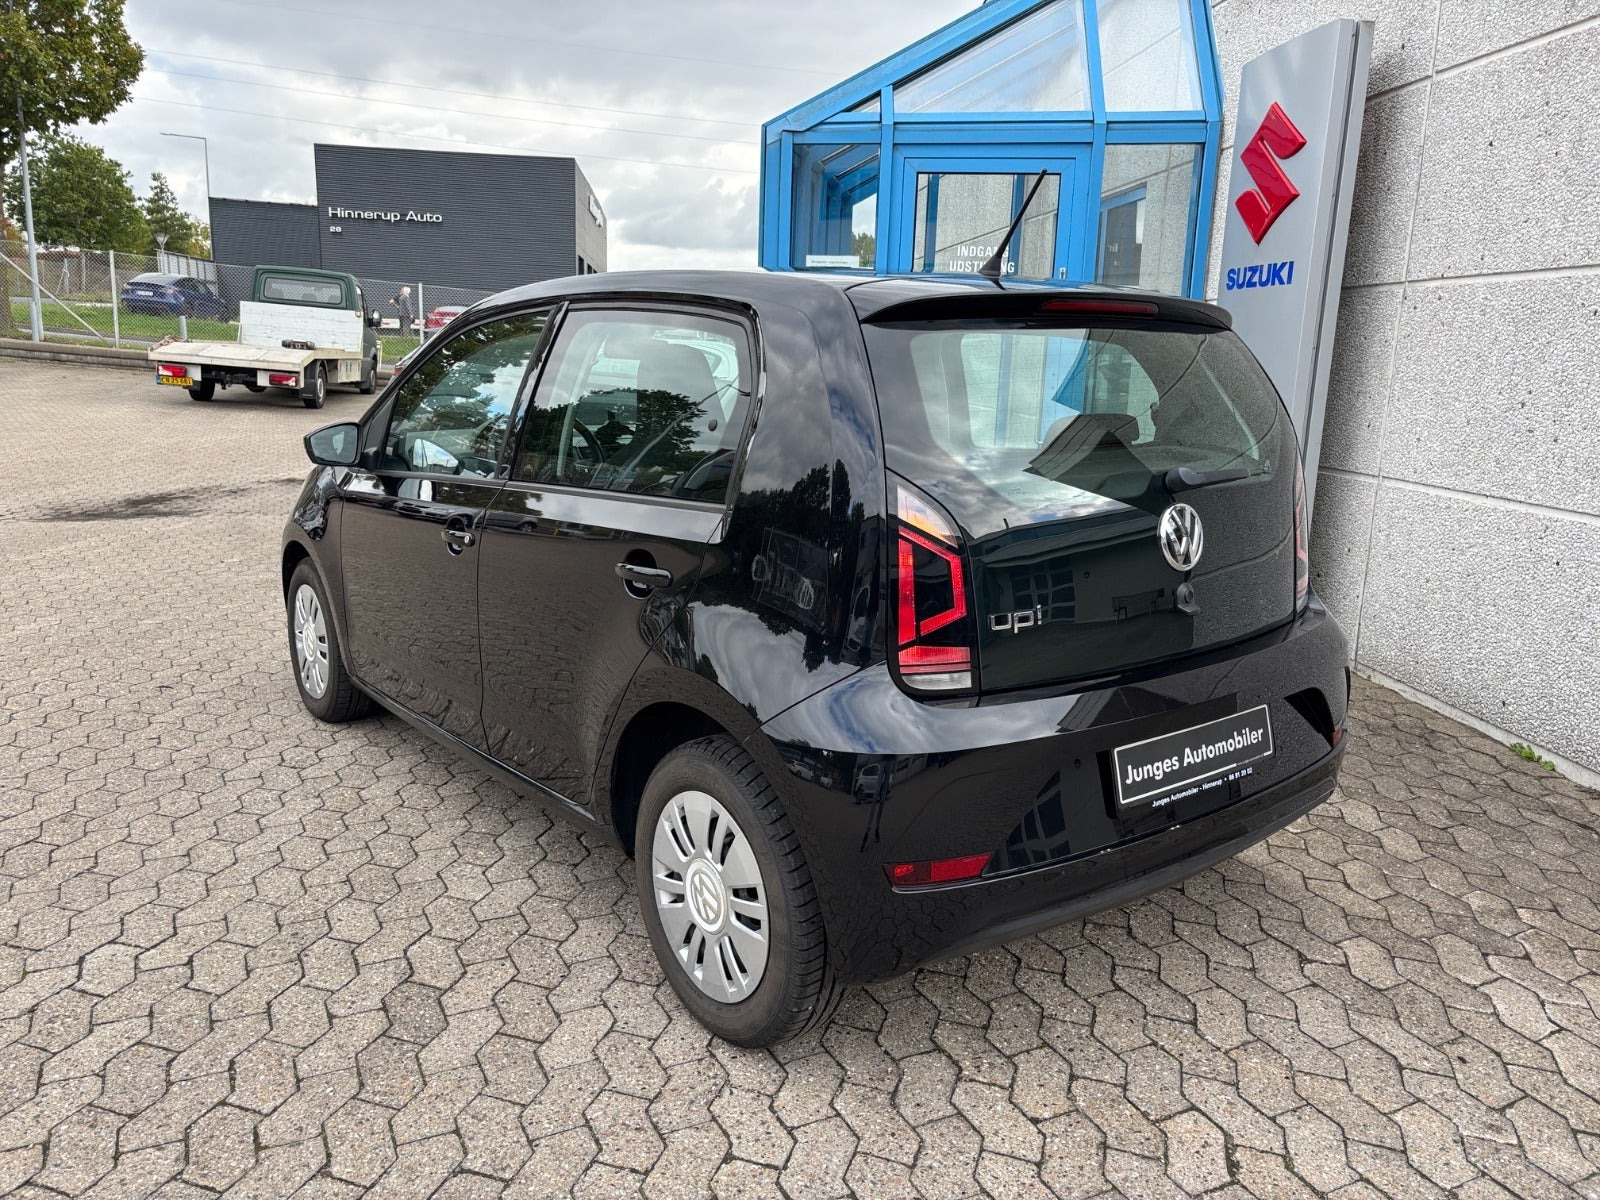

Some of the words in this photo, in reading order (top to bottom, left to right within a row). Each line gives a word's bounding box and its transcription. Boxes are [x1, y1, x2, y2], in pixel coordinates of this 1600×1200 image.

[328, 206, 401, 223] Hinnerup
[405, 210, 443, 223] Auto
[1226, 261, 1295, 291] SUZUKI
[989, 604, 1042, 634] up!
[1125, 756, 1179, 784] Junges
[1183, 727, 1264, 767] Automobiler
[1152, 796, 1170, 808] Junges
[1170, 786, 1199, 801] Automobiler
[1202, 779, 1223, 790] Hinnerup
